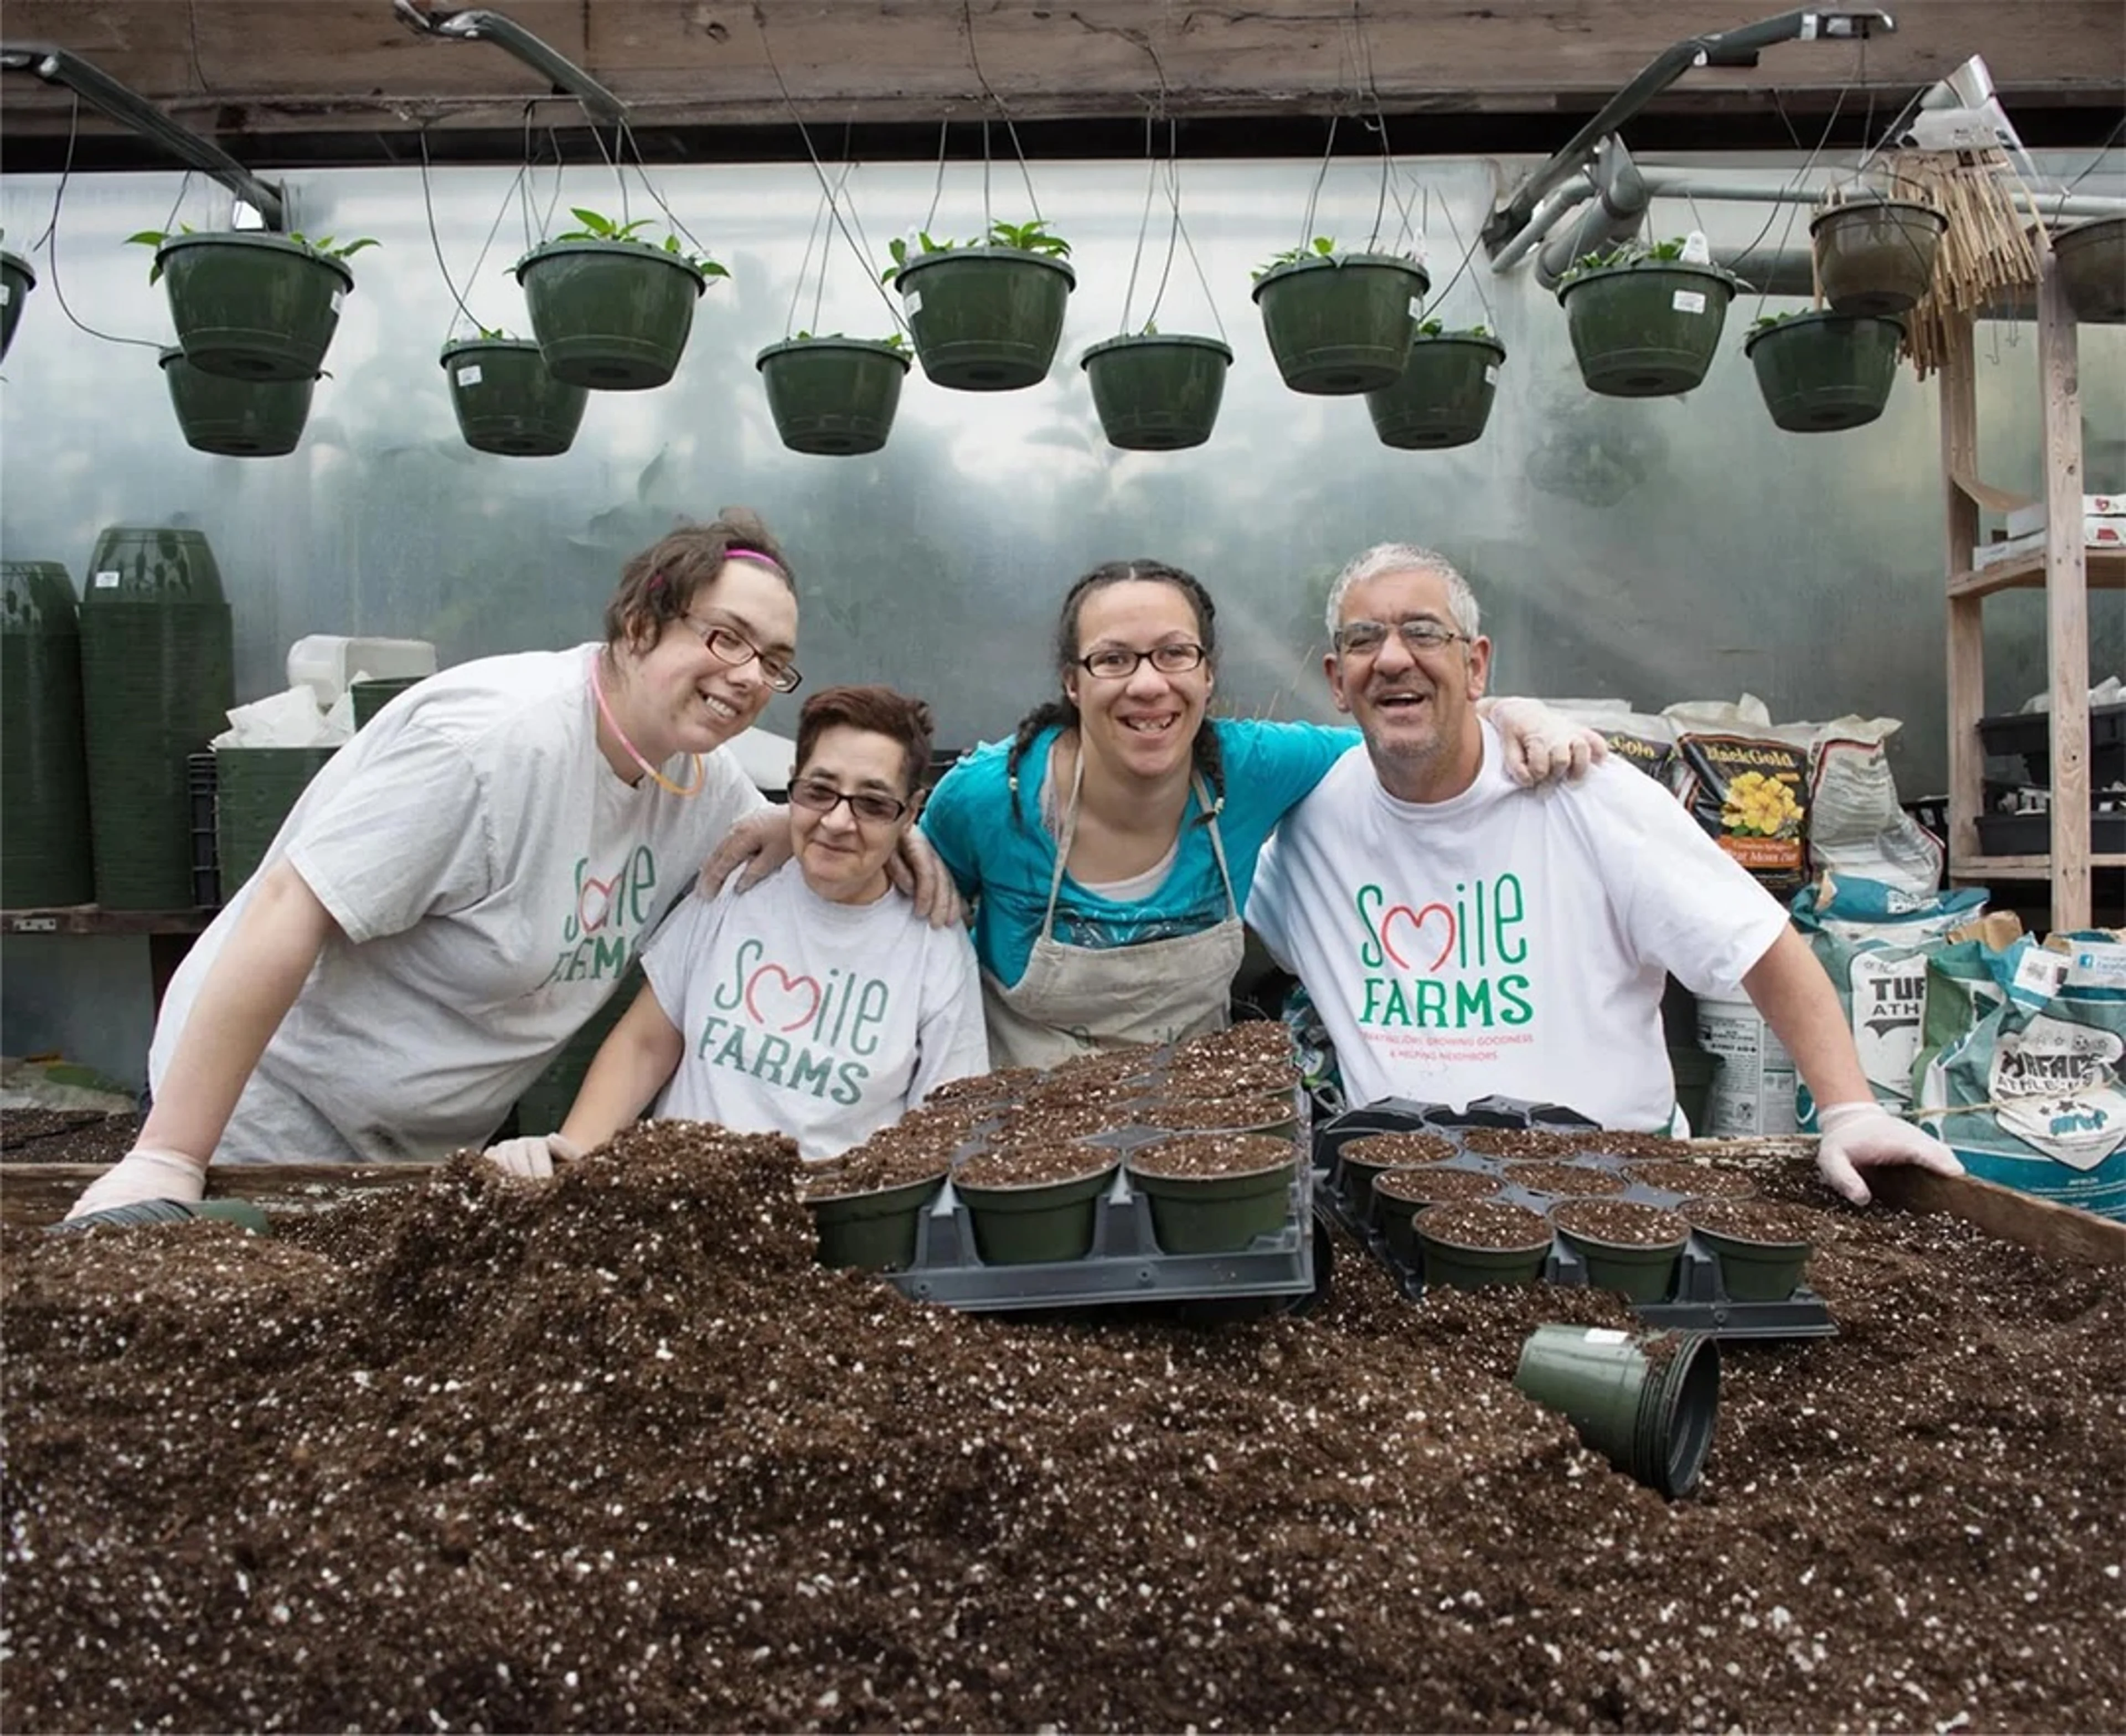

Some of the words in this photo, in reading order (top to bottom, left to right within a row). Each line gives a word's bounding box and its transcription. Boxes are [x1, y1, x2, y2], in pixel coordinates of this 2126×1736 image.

[1357, 873, 1526, 972] Smile
[714, 939, 889, 1055] Smile
[1359, 974, 1533, 1028] FARMS
[699, 1016, 869, 1105] FARMS
